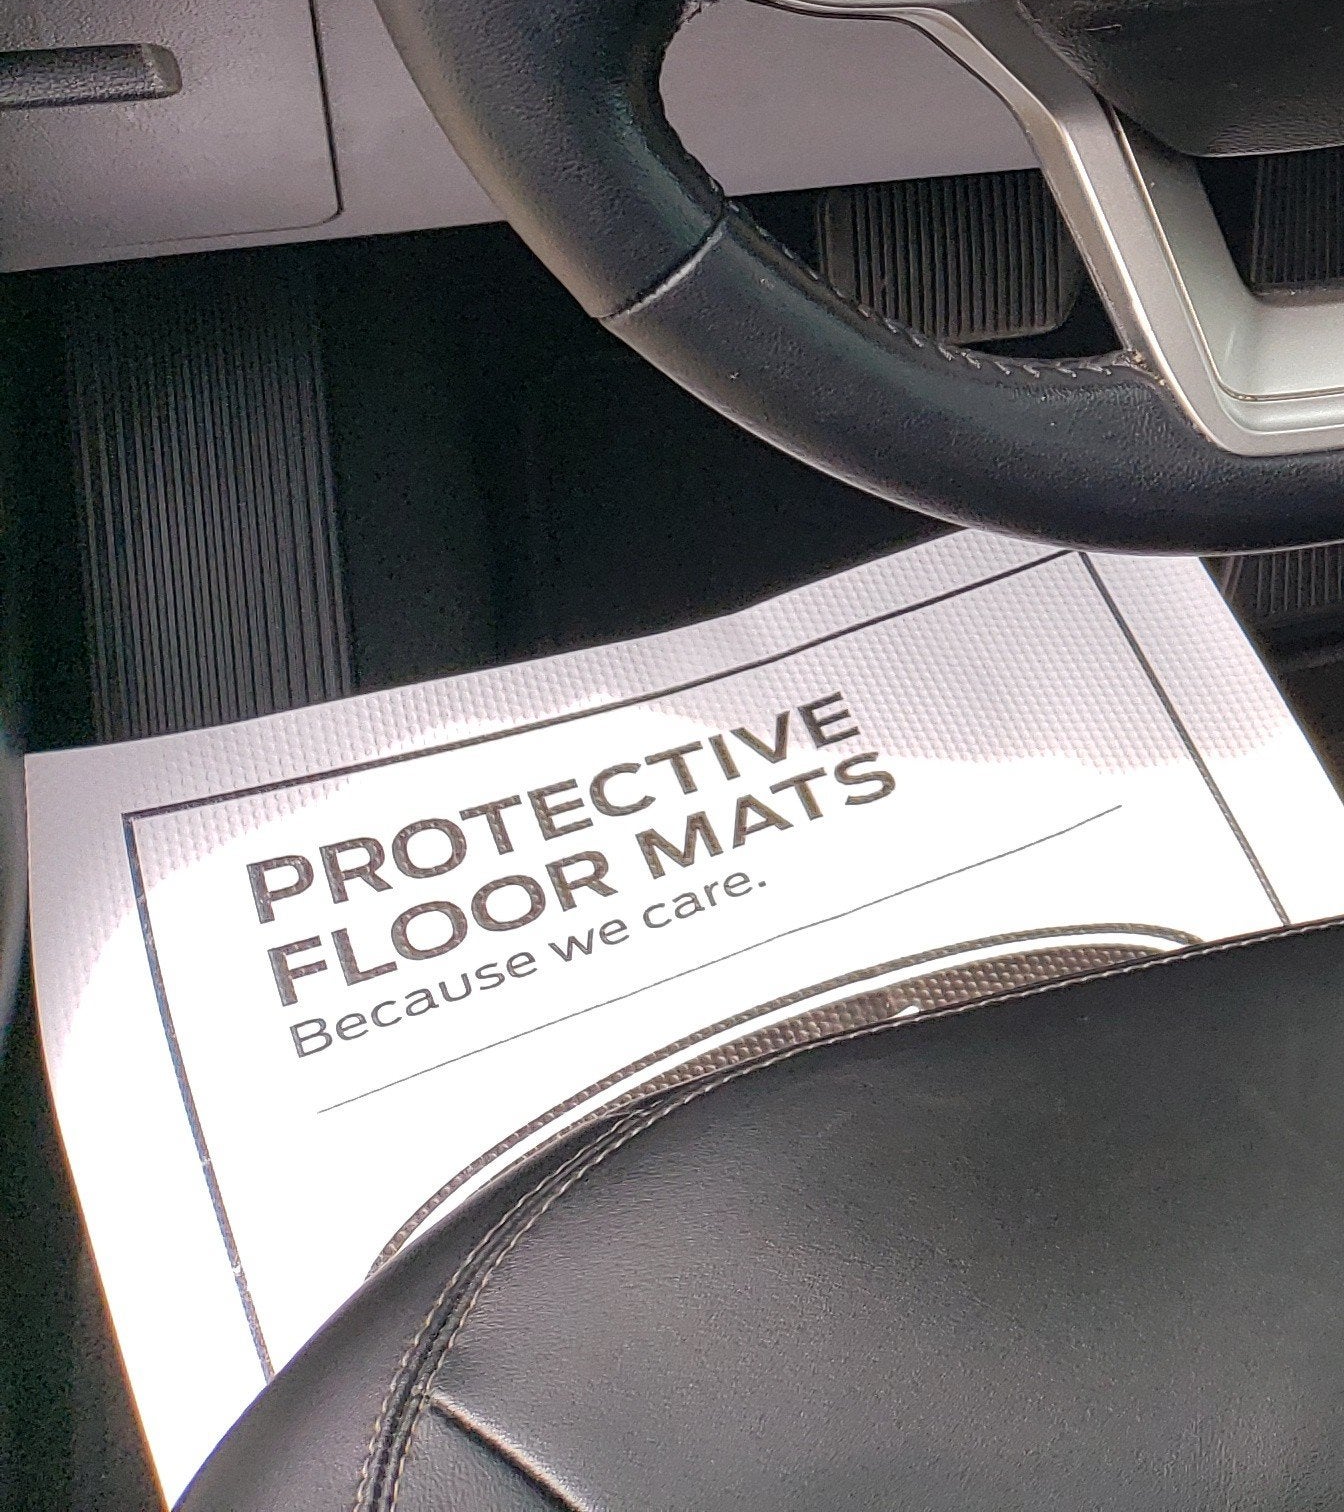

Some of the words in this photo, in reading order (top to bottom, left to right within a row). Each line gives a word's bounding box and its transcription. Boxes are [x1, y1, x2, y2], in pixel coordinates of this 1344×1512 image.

[245, 691, 861, 925] PROTECTIVE
[266, 849, 619, 1006] FLOOR
[634, 751, 897, 879] MATS
[289, 950, 538, 1058] Because
[547, 917, 629, 962] we
[641, 871, 768, 931] care.
